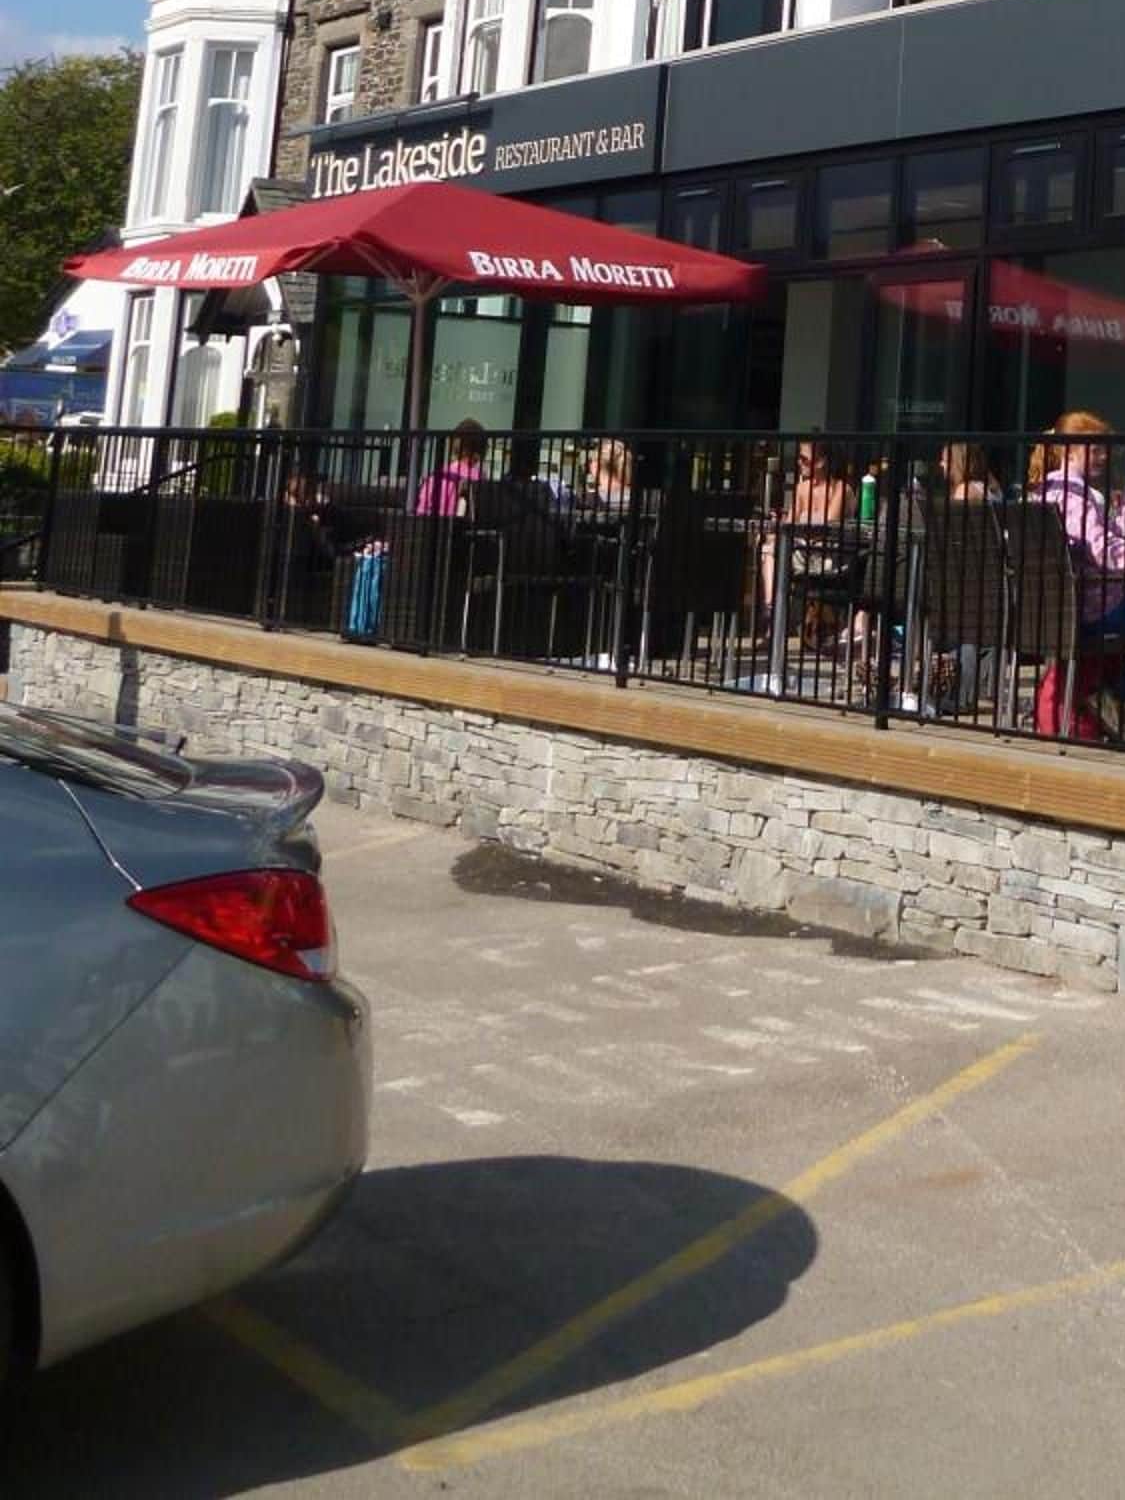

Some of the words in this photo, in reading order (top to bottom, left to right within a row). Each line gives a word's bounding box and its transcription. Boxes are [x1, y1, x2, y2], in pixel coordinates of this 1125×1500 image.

[310, 146, 358, 199] The
[360, 127, 487, 191] Lakeside
[494, 131, 595, 172] RESTAURANT
[609, 122, 646, 153] BAR
[183, 252, 259, 280] MORETTI
[467, 251, 564, 281] BIRRA
[569, 256, 675, 289] MORETTI
